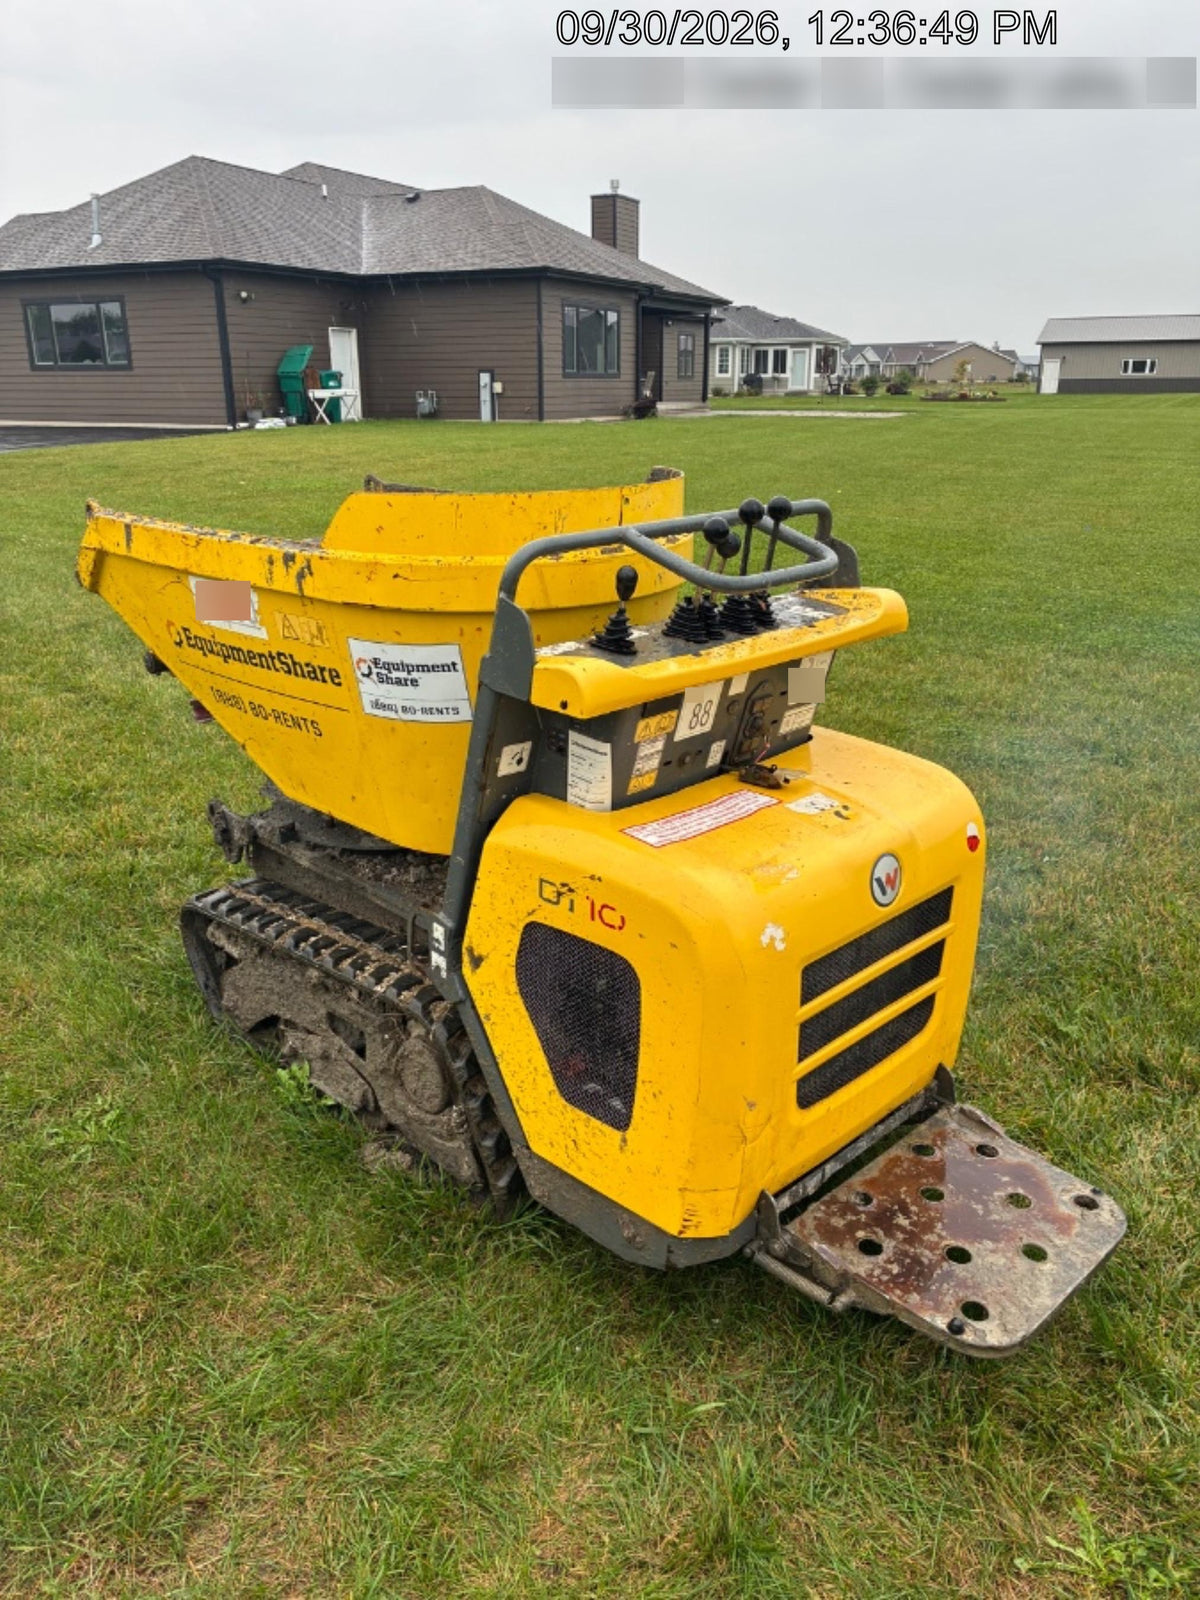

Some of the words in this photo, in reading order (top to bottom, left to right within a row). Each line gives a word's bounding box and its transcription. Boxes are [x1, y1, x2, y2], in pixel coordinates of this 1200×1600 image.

[182, 626, 343, 687] EquipmentShare
[373, 657, 459, 675] Equipment
[376, 672, 421, 688] Share
[249, 701, 323, 737] 80-RENTS
[401, 705, 460, 716] 80-RENTS
[689, 700, 713, 730] 88
